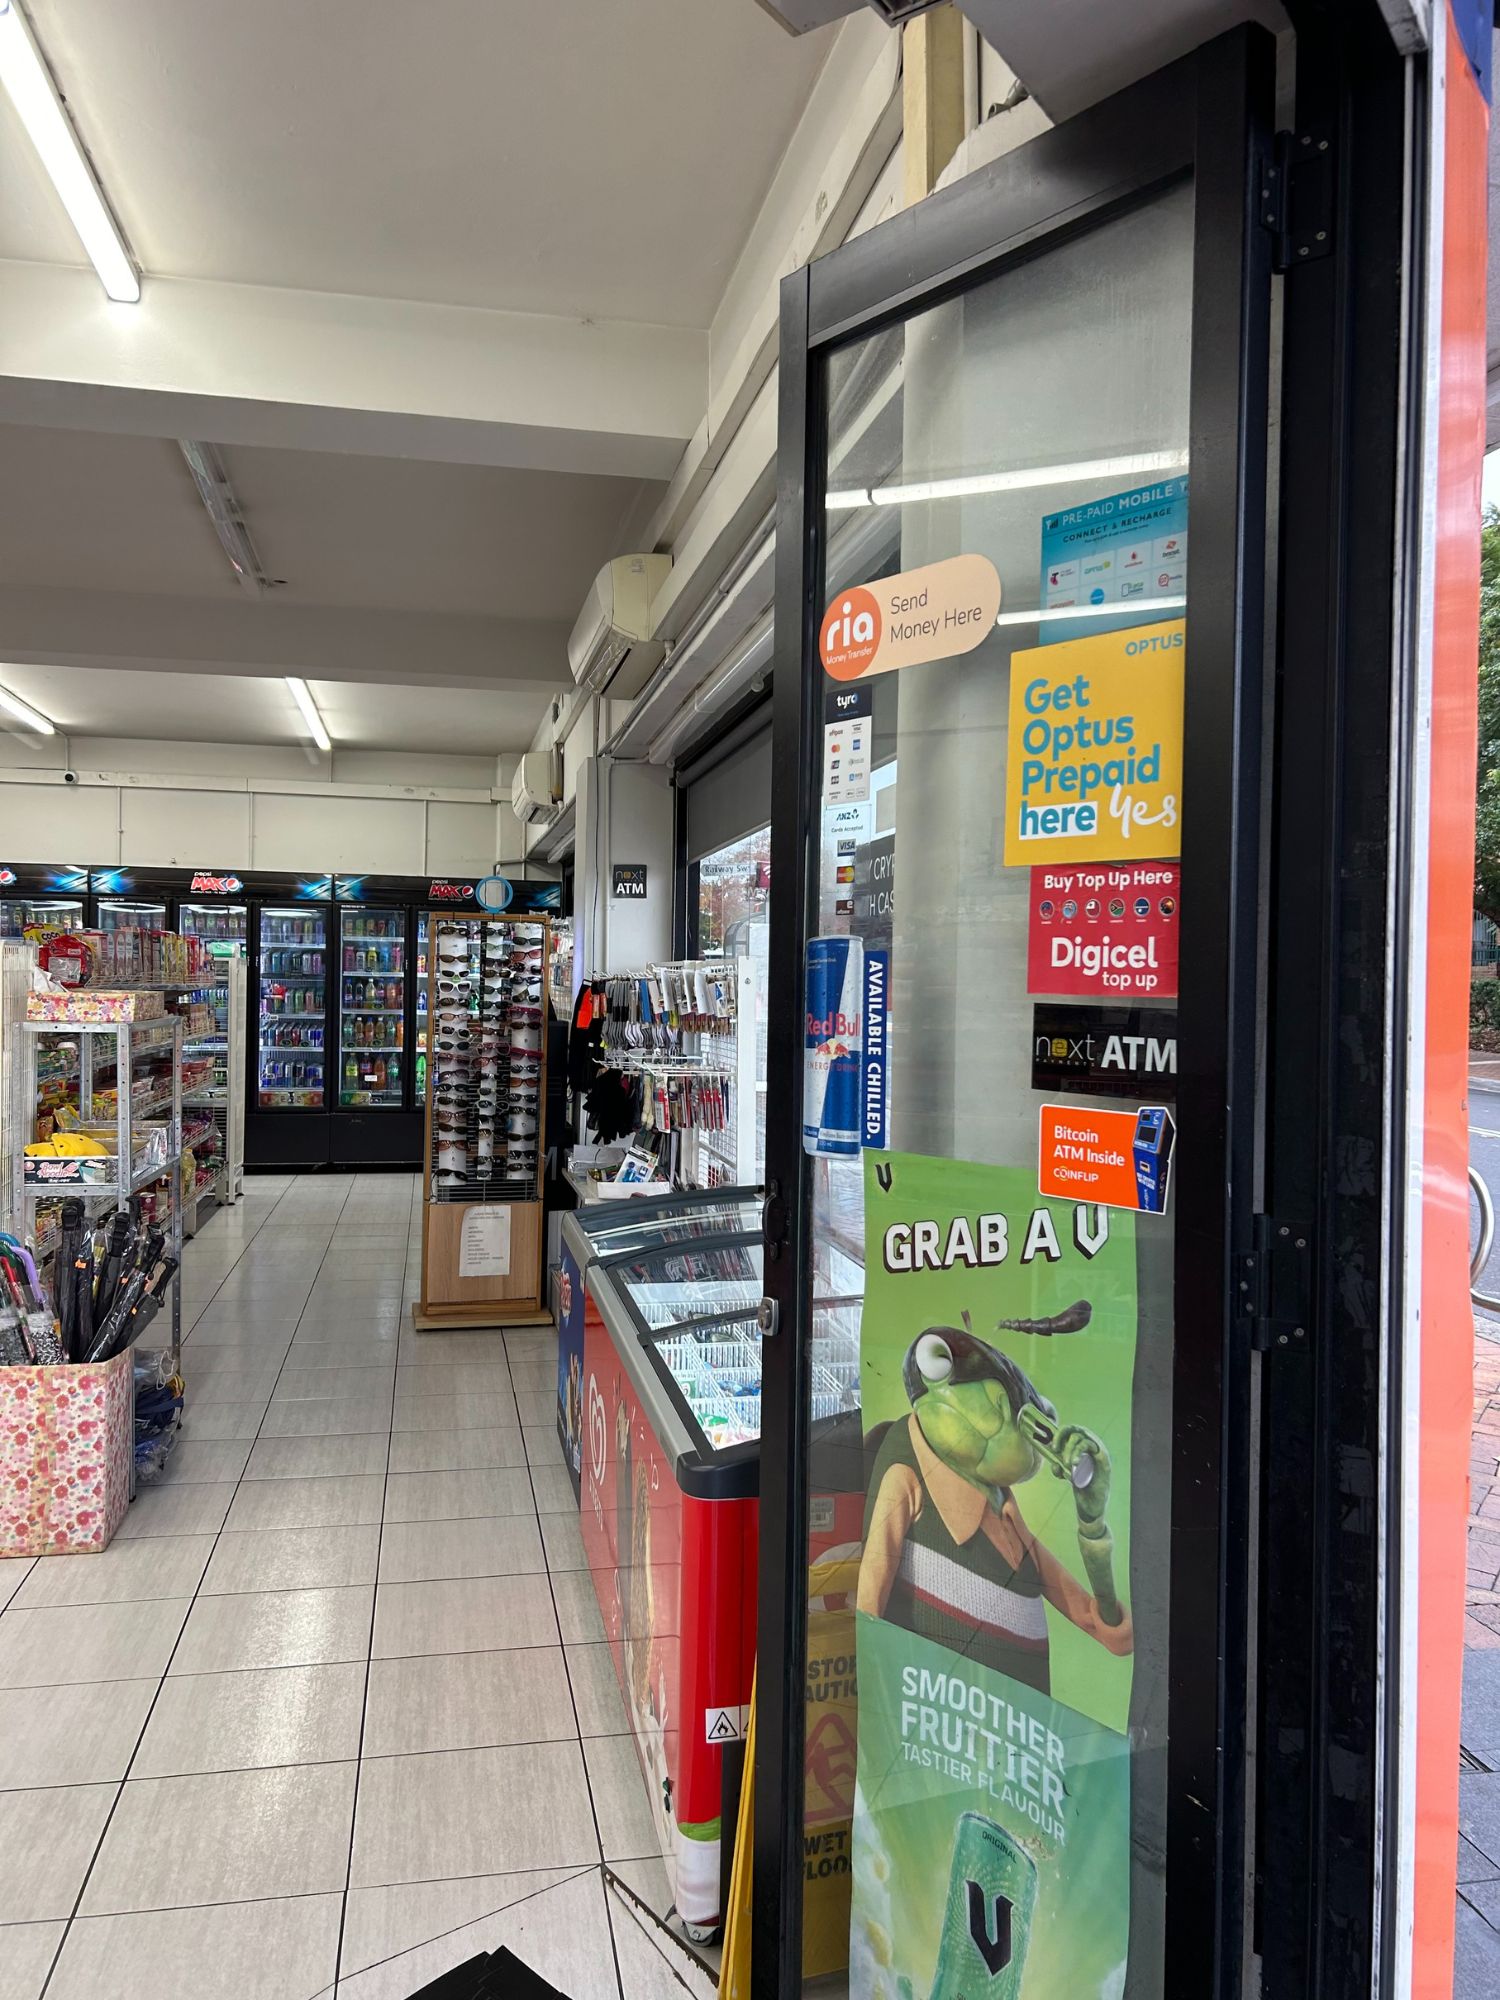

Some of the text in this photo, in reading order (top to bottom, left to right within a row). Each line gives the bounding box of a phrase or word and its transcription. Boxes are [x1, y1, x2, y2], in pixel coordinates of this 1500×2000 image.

[1062, 484, 1173, 526] PRE-PAID MOBILE
[1063, 525, 1108, 543] CONNECT
[1121, 507, 1172, 527] RECHARGE
[890, 588, 928, 616] Send
[827, 601, 874, 651] ria
[890, 607, 982, 643] Money Here
[826, 647, 873, 665] Money Transfer
[1125, 632, 1183, 656] OPTUS
[837, 693, 858, 710] tyro
[1024, 675, 1090, 714] Get
[1023, 716, 1134, 761] Optus
[1022, 744, 1160, 800] Prepaid
[836, 812, 851, 821] ANZ
[1020, 800, 1096, 836] here
[840, 841, 855, 850] VISA
[616, 869, 643, 880] next
[704, 864, 733, 874] Railway
[1044, 870, 1173, 893] Buy Top Up Here
[190, 876, 229, 891] MAX
[428, 885, 464, 898] MAX
[616, 882, 644, 894] ATM
[1051, 935, 1158, 976] Digicel
[1102, 971, 1158, 991] top up
[806, 1011, 860, 1037] Red Bull
[866, 960, 883, 1140] AVAILABLE CHILLED.
[1036, 1033, 1177, 1074] next ATM
[1054, 1125, 1099, 1143] Bitcoin
[1053, 1145, 1125, 1167] ATM Inside
[1053, 1166, 1099, 1183] COINFLIP
[884, 1213, 1009, 1273] GRAB
[1020, 1208, 1062, 1264] A
[902, 1666, 1065, 1775] SMOOTHER
[901, 1701, 1065, 1819] FRUITIER
[901, 1742, 1066, 1847] TASTIER FLAVOUR
[803, 1831, 848, 1856] WET
[982, 1831, 1017, 1864] ORIGINAL
